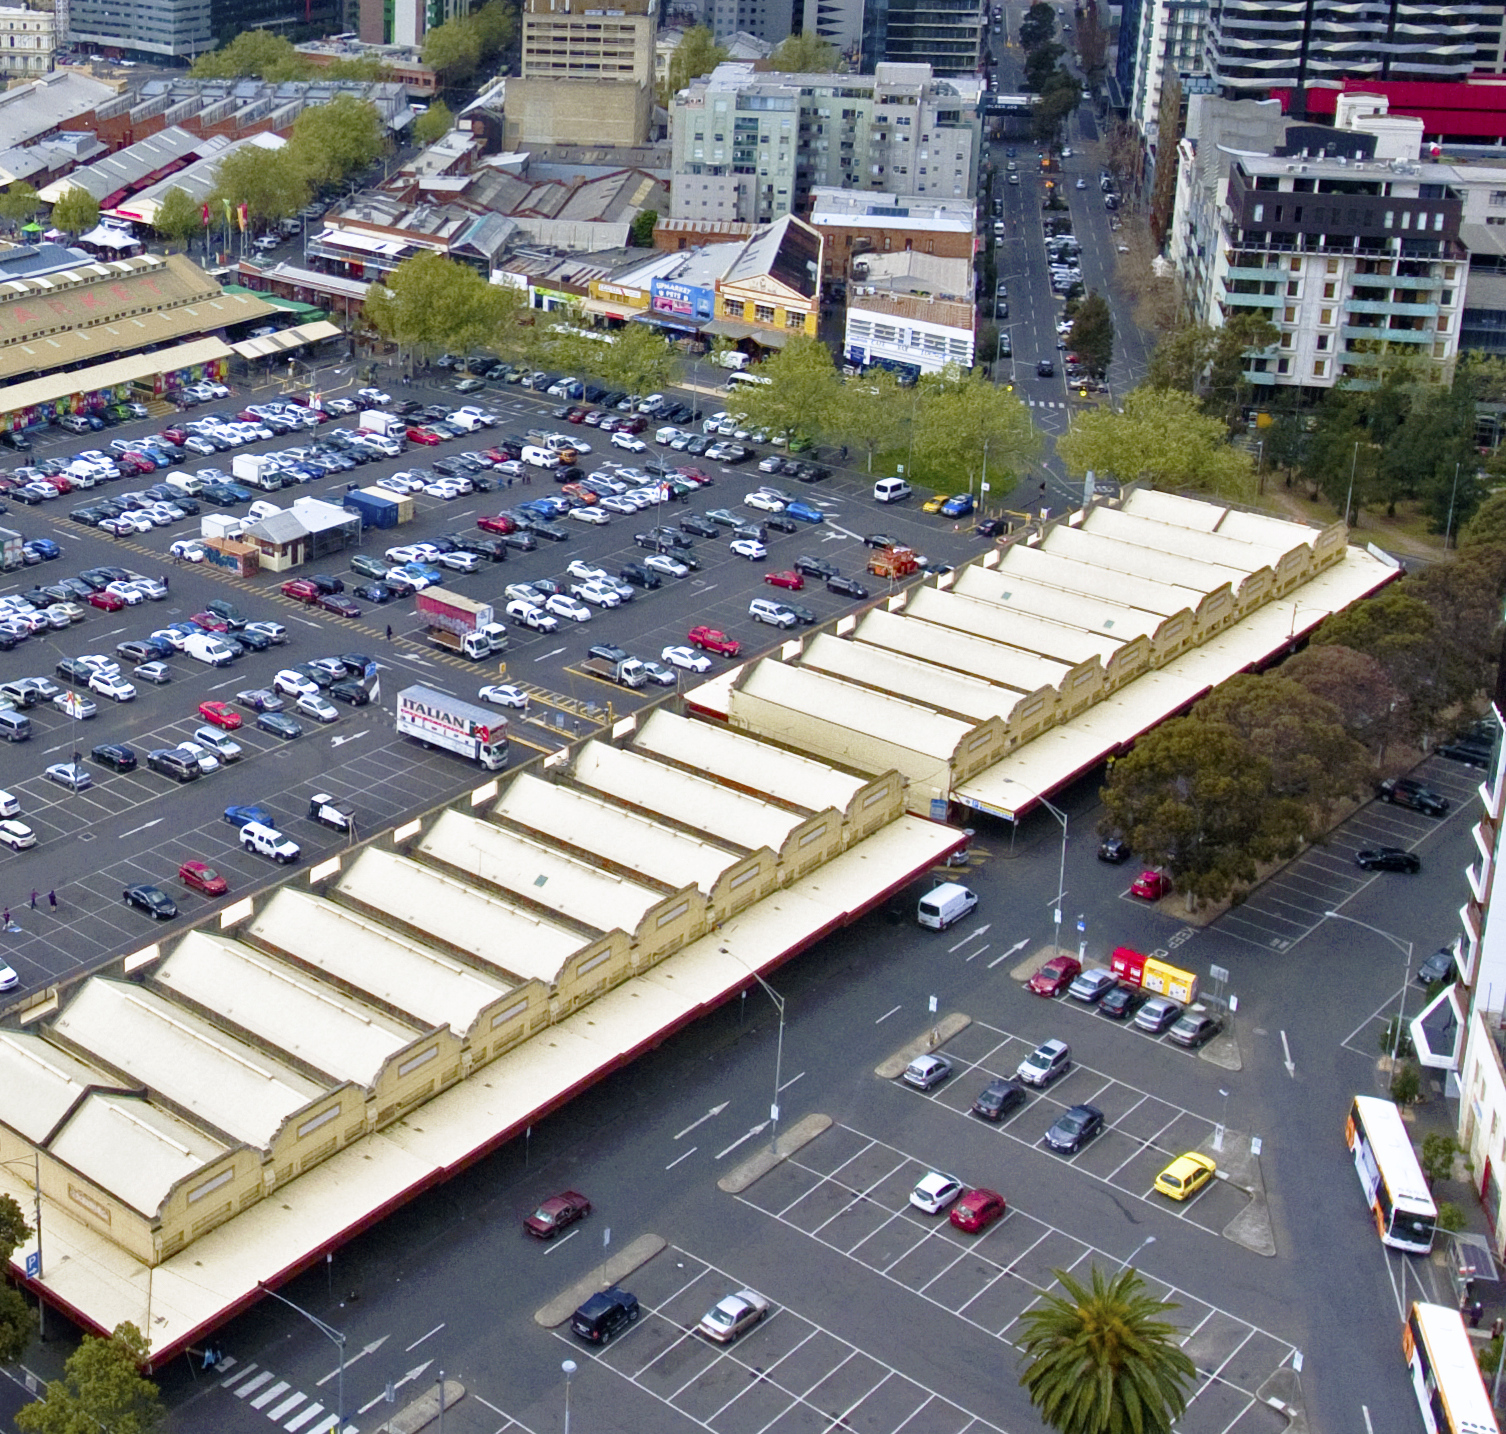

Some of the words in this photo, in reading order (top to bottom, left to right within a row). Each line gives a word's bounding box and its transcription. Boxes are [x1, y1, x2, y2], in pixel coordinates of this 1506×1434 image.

[656, 282, 692, 295] UPMARKET
[665, 290, 681, 300] PETS
[403, 698, 465, 729] ITALIAN
[1168, 926, 1201, 949] KEEP
[29, 1255, 37, 1269] P
